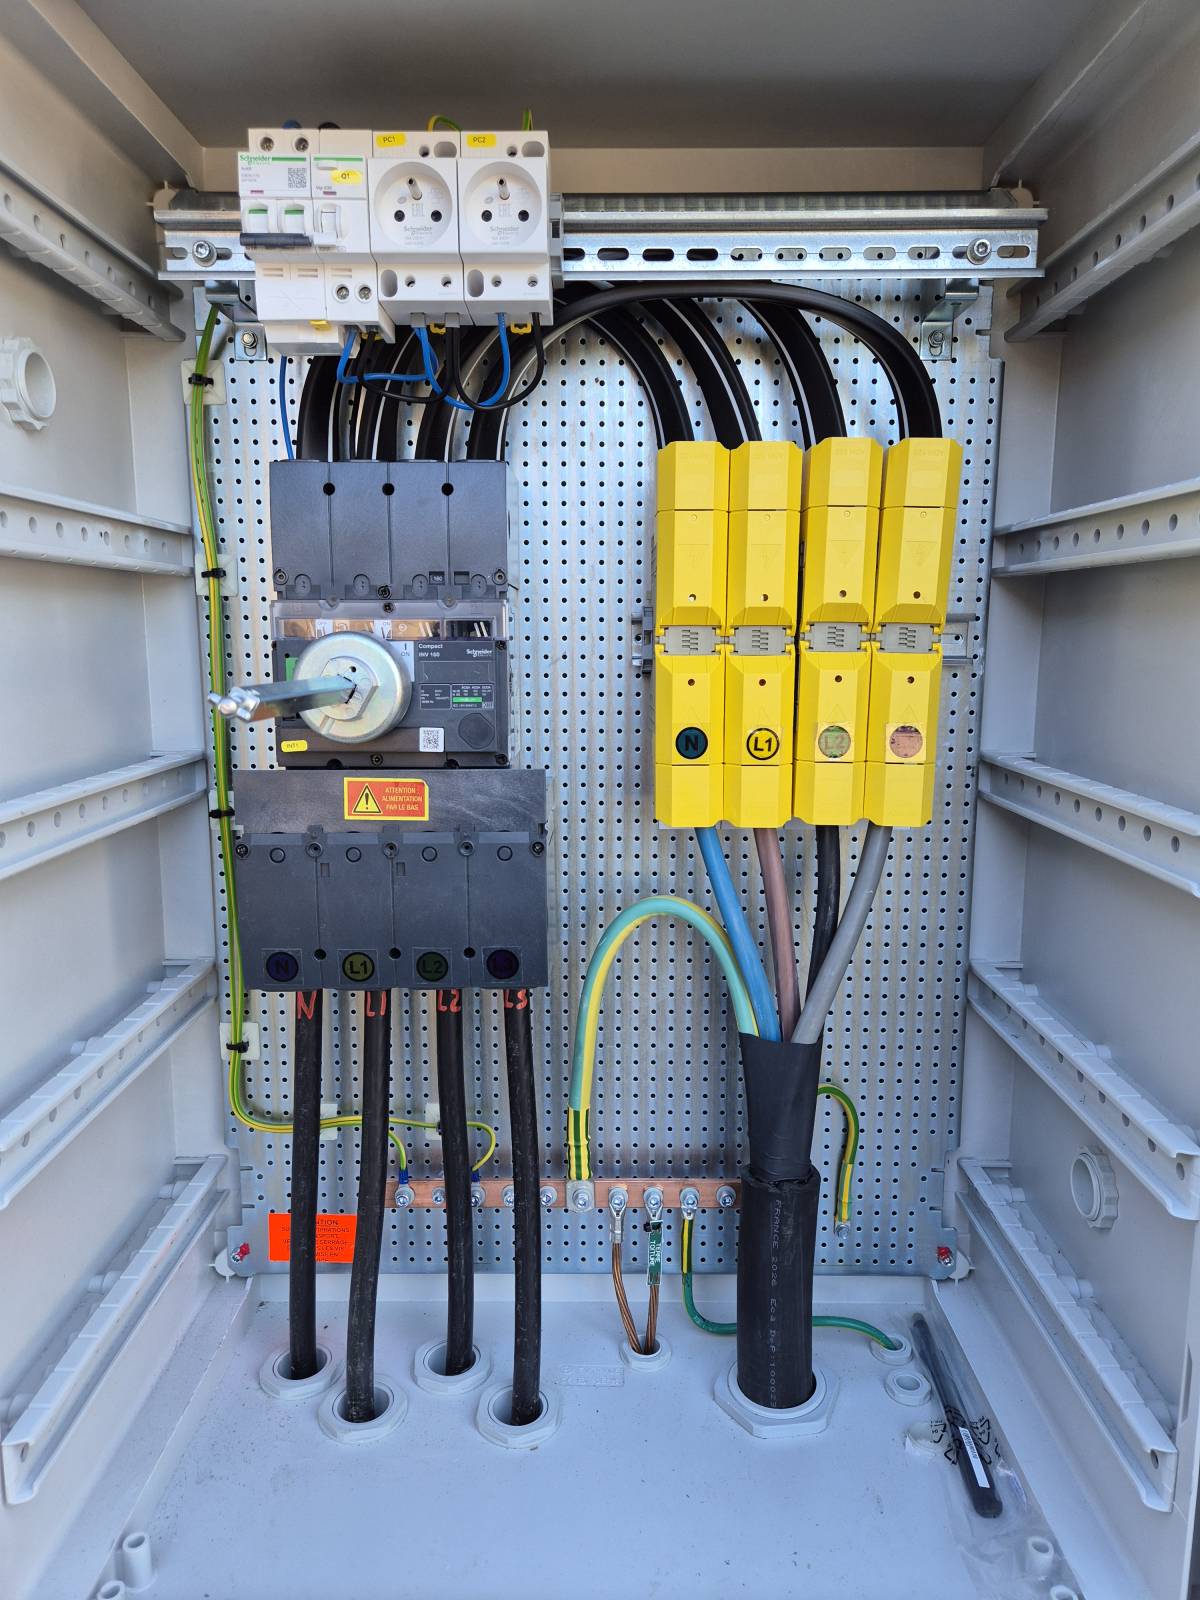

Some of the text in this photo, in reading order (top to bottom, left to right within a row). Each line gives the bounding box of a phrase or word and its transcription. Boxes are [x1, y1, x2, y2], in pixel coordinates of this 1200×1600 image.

[684, 735, 698, 751] N
[753, 736, 773, 752] L1
[823, 736, 846, 751] L2
[275, 960, 290, 975] N
[350, 959, 368, 975] L1
[422, 958, 443, 974] L2
[296, 989, 317, 1020] N
[366, 989, 387, 1017] L1
[437, 988, 462, 1013] L2
[772, 1199, 782, 1249] FRANCE
